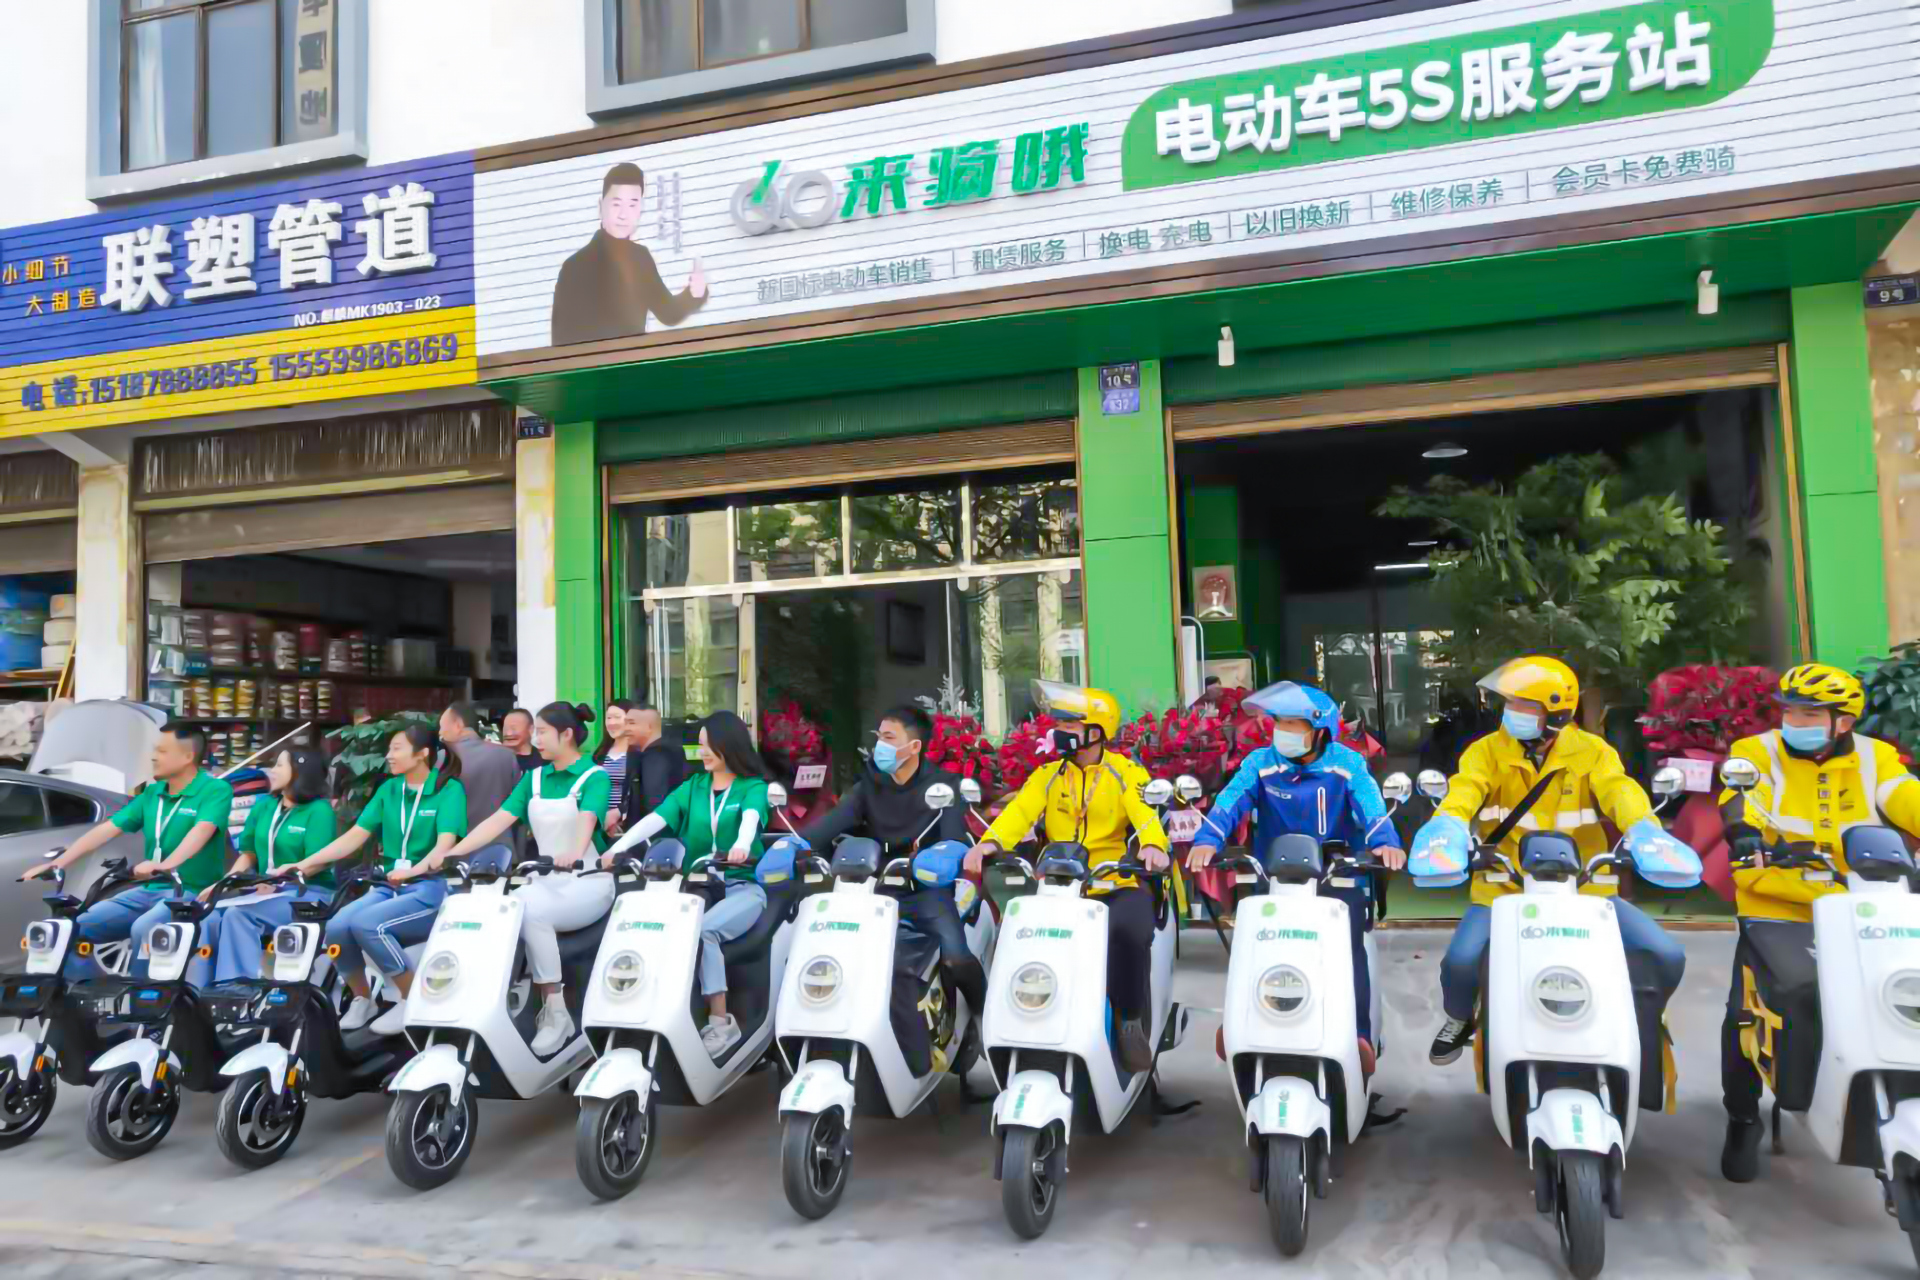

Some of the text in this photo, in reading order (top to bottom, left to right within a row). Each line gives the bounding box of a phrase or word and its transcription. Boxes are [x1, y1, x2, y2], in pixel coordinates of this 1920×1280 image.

[1155, 10, 1712, 164] 电动车5S服务站
[100, 182, 438, 313] 联塑管道
[757, 257, 933, 302] 新国标电动车销售
[972, 238, 1067, 273] 租赁服务
[1245, 200, 1351, 235] 以旧换新
[1390, 178, 1504, 217] 维修保养
[1552, 146, 1736, 194] 会员卡免费骑
[2, 255, 71, 285] 小细节
[24, 287, 98, 317] 大制造
[293, 295, 441, 327] NO.MK1903-023
[269, 332, 459, 382] 15559986869
